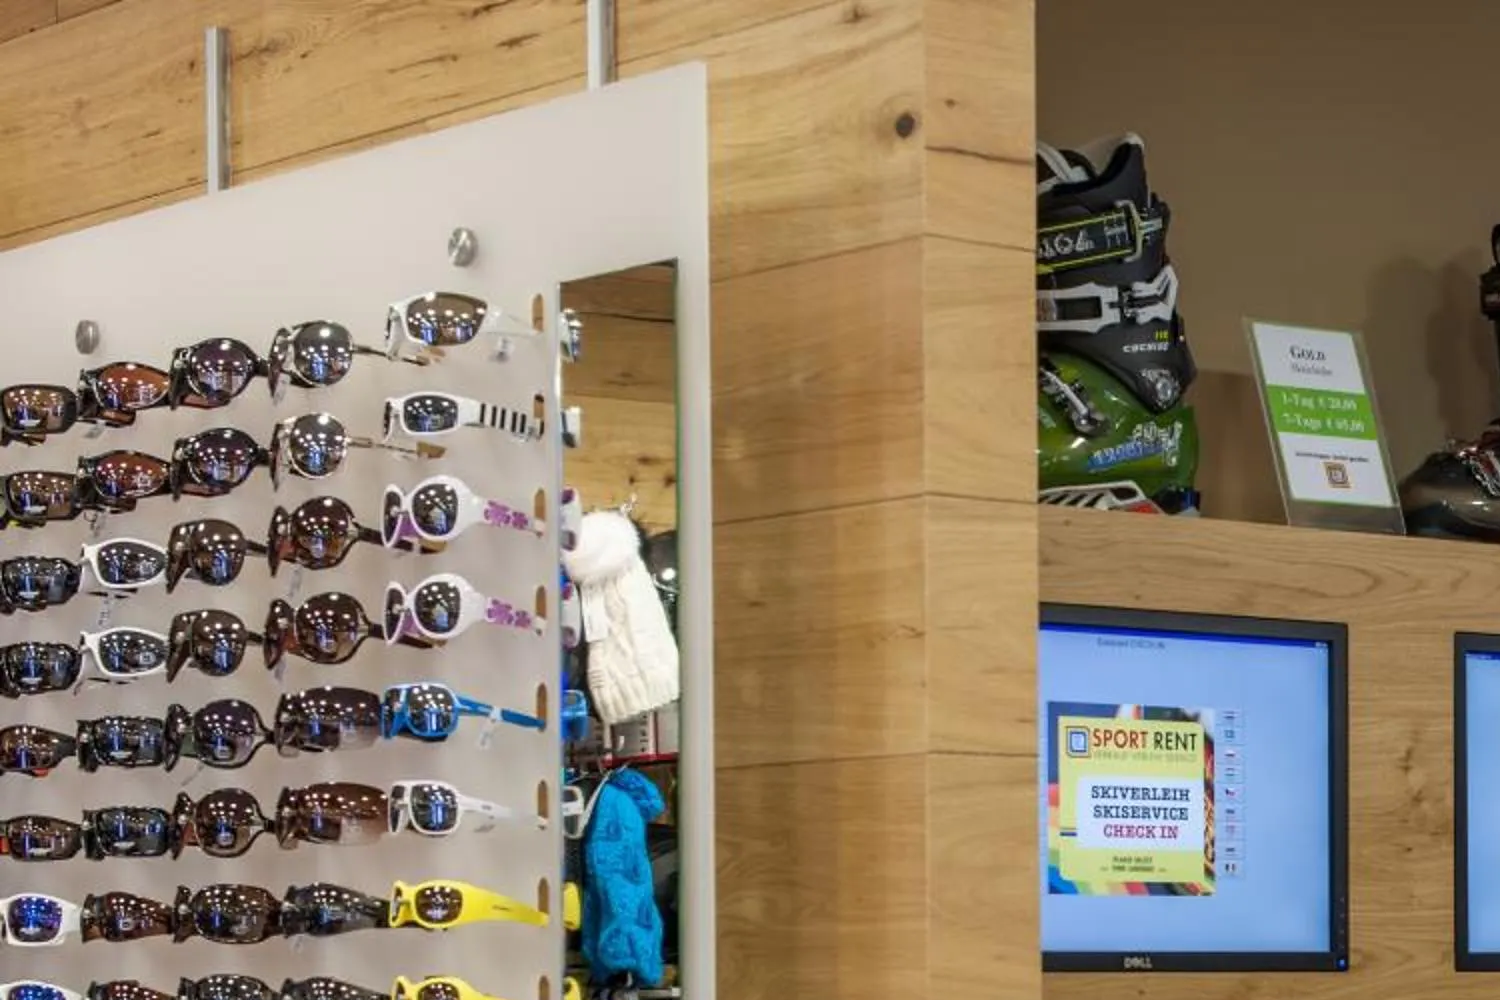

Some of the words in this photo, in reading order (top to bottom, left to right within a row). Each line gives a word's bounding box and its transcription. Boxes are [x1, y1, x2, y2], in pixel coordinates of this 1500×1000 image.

[1093, 728, 1148, 749] SPORT
[1153, 731, 1198, 752] RENT
[1091, 785, 1190, 802] SKIVERLEIH
[1093, 805, 1189, 821] SKISERVICE
[1103, 824, 1157, 839] CHECK
[1161, 826, 1179, 840] IN
[1123, 956, 1152, 969] DELL
